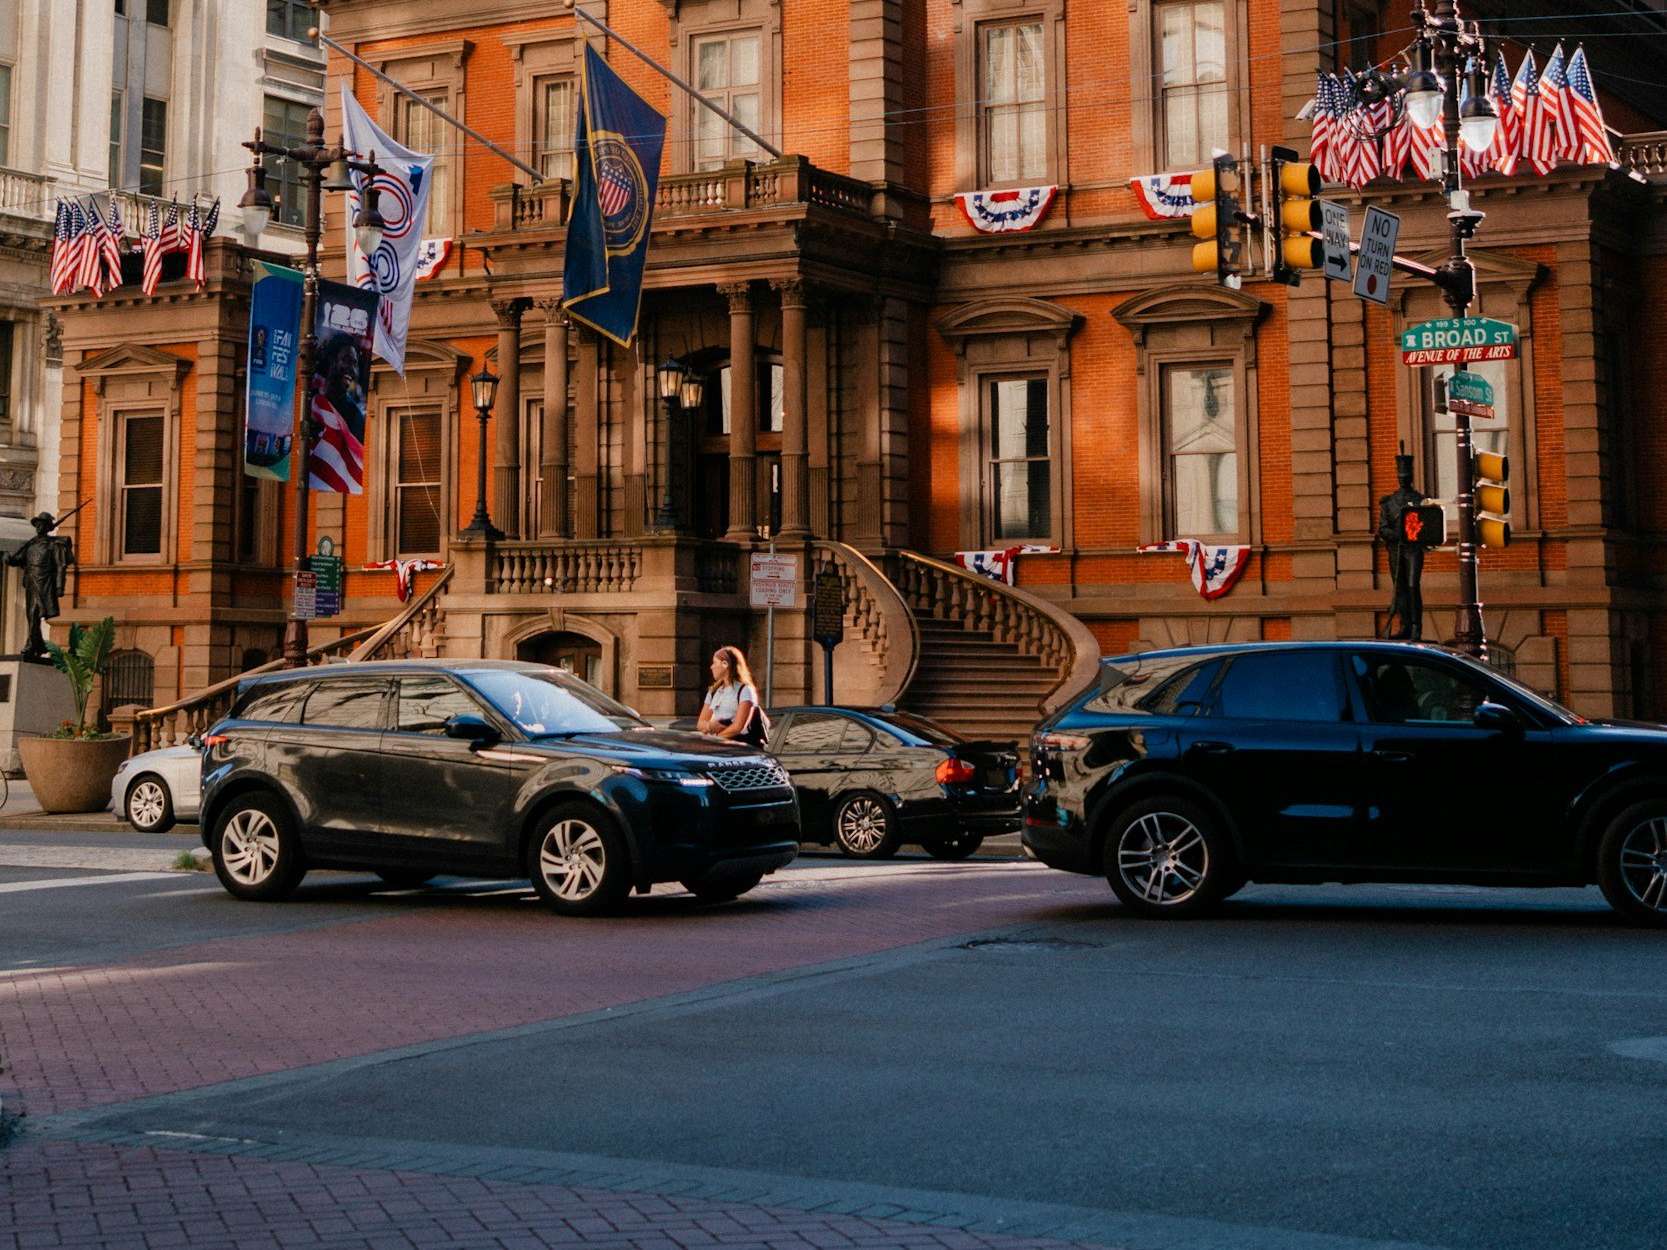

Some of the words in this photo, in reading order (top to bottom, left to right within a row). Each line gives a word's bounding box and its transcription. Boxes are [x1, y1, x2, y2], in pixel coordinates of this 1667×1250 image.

[1325, 208, 1345, 229] ONE
[1372, 215, 1391, 238] NO
[1326, 229, 1347, 249] WAY
[1367, 237, 1390, 258] TURN
[1360, 255, 1372, 270] ON
[1374, 258, 1389, 276] RED
[1453, 319, 1459, 328] S
[1421, 328, 1487, 348] BROAD
[1494, 331, 1509, 343] ST
[1405, 350, 1445, 364] AVENUE
[1446, 348, 1460, 361] OF
[1463, 347, 1482, 360] THE
[1485, 345, 1511, 359] ARTS
